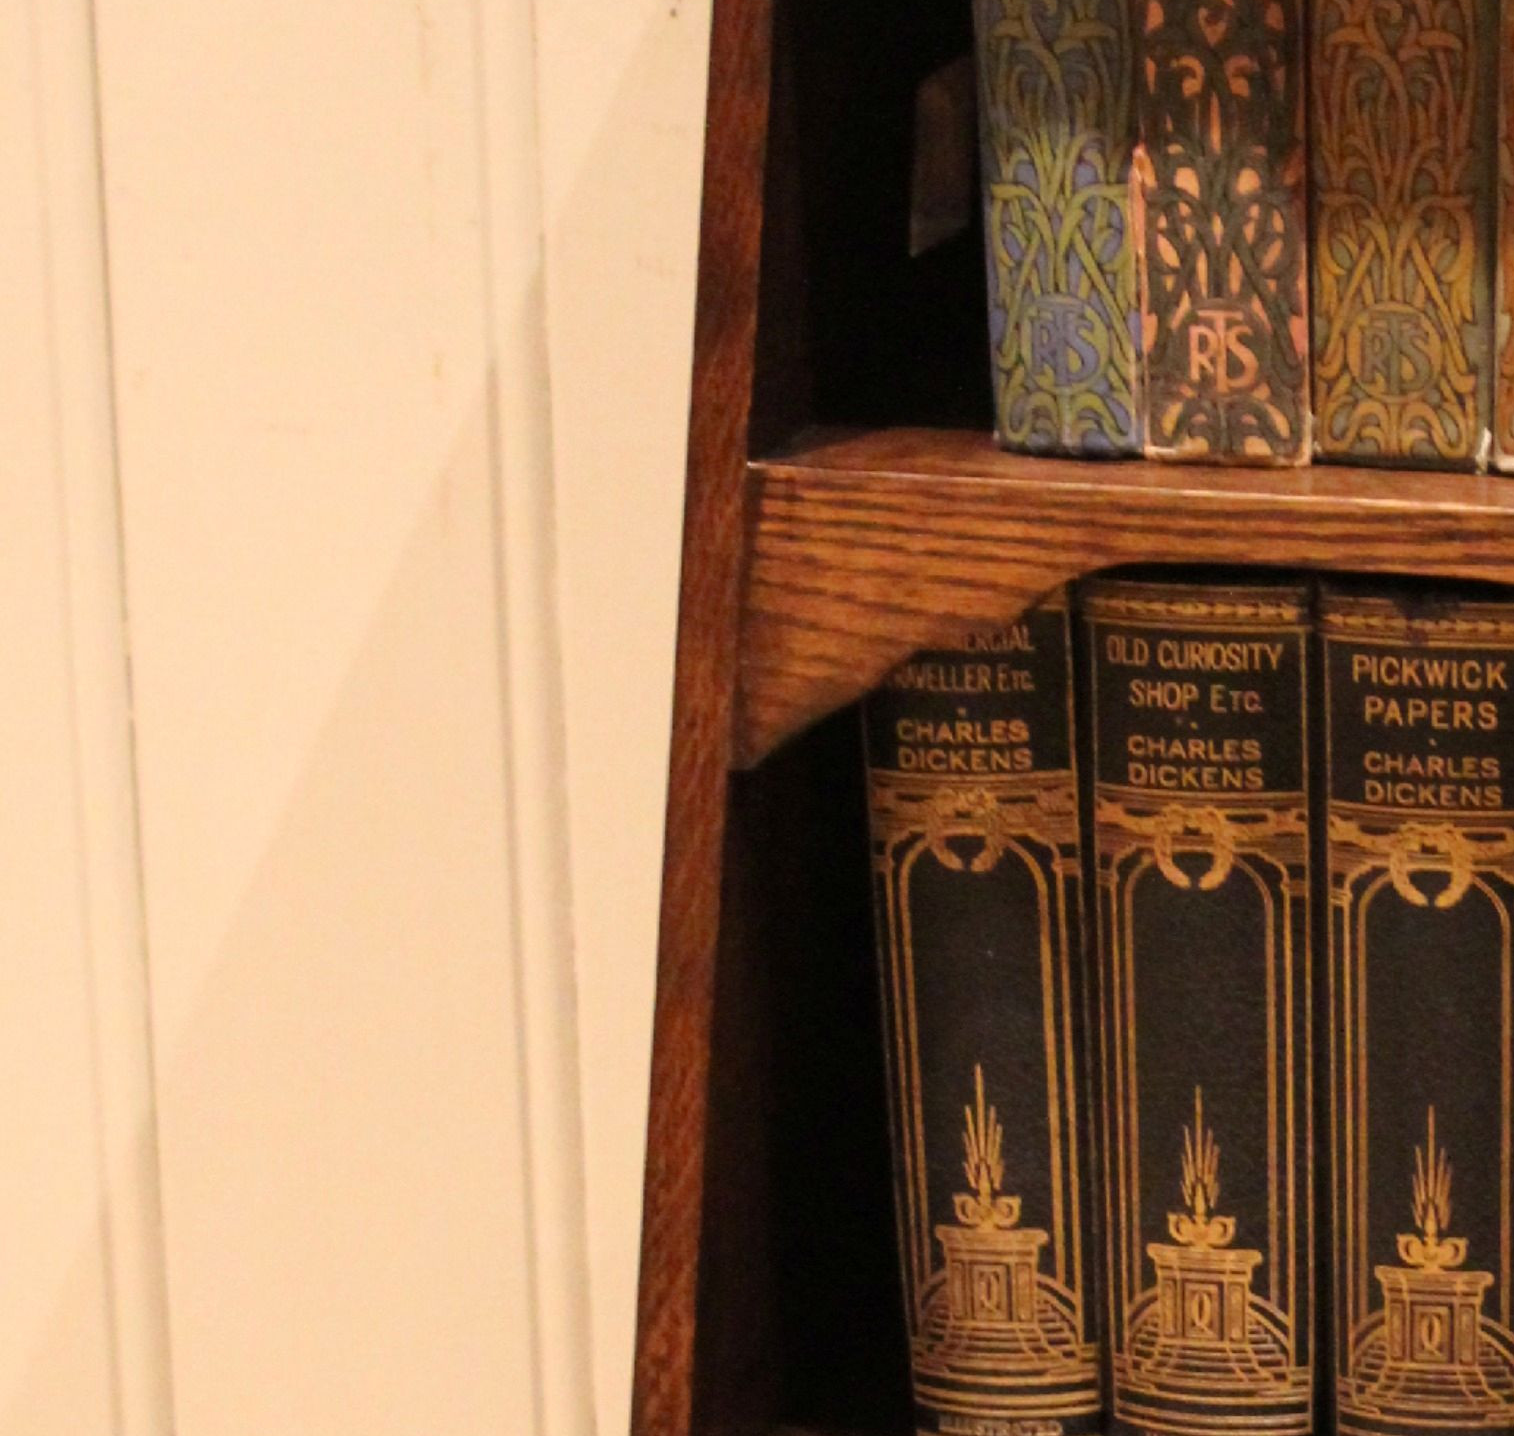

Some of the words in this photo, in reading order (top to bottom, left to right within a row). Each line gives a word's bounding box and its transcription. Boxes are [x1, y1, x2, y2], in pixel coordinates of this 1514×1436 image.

[1105, 634, 1150, 667] OLD
[1156, 639, 1286, 673] CURIOSITY
[1351, 652, 1509, 692] PICKWICK
[1128, 678, 1200, 712] SHOP
[1364, 694, 1500, 732] PAPERS
[896, 718, 1030, 745] CHARLES
[897, 745, 1034, 773] DICKENS
[1126, 734, 1263, 762] CHARLES
[1127, 761, 1265, 791] DICKENS
[1363, 749, 1502, 780] CHARLES
[1364, 778, 1504, 808] DICKENS
